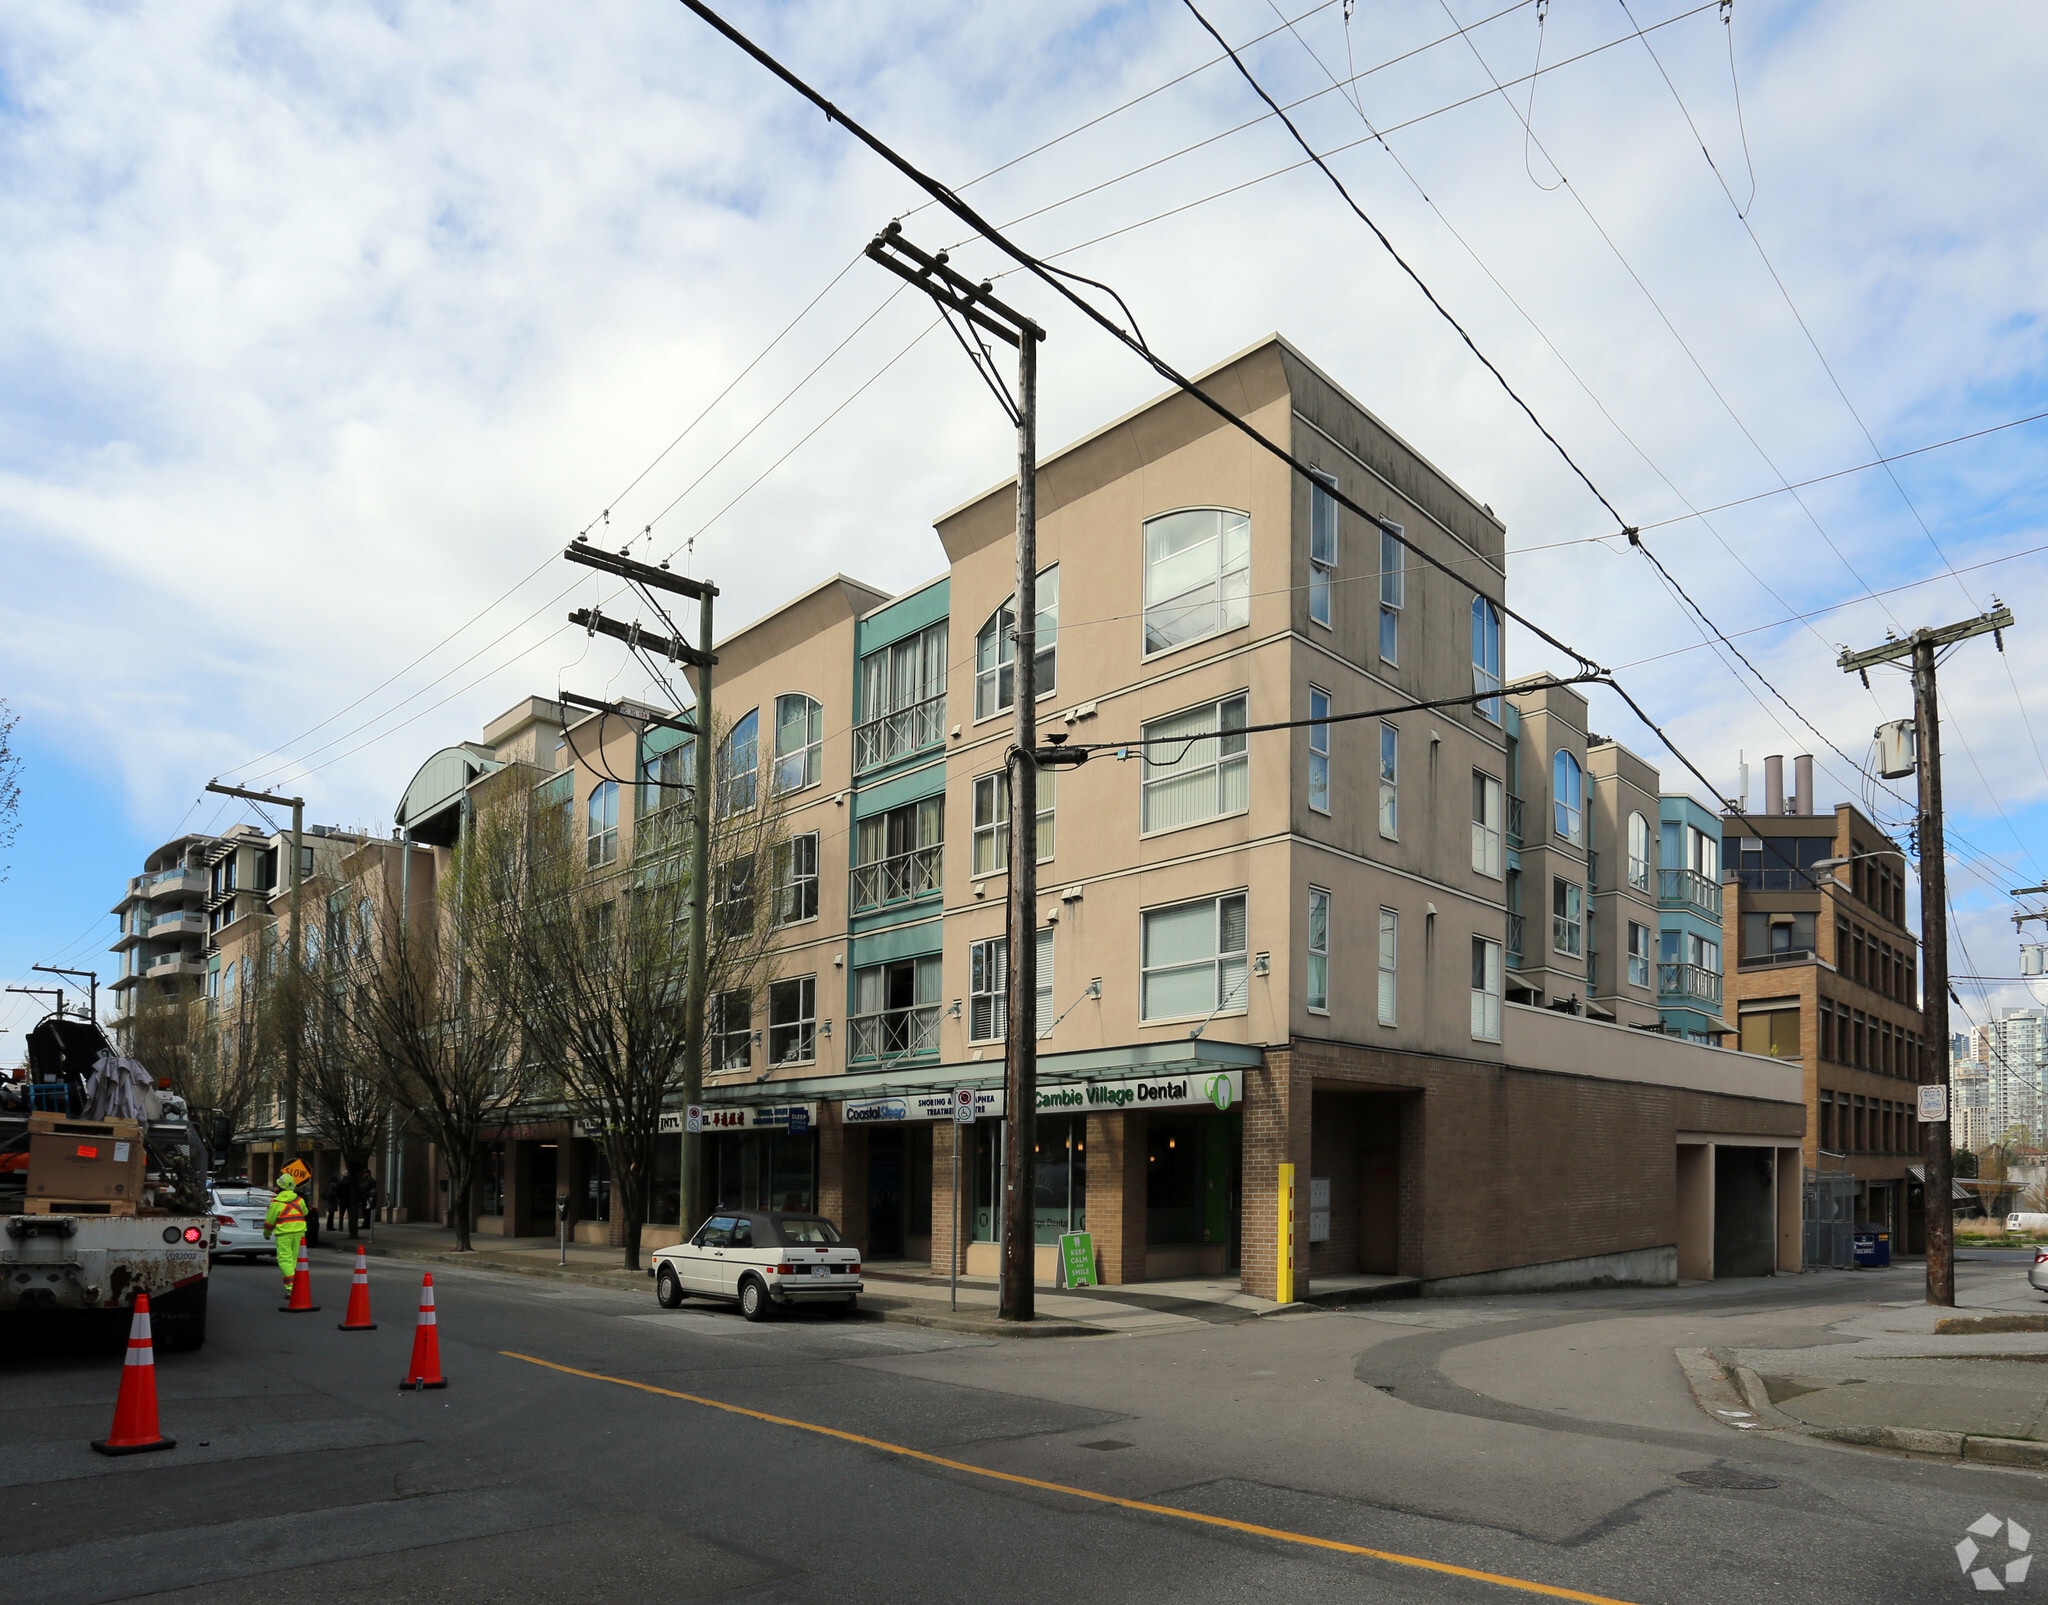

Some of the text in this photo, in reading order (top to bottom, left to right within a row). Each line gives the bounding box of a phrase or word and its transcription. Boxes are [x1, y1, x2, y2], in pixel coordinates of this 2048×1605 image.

[1035, 1080, 1188, 1108] Cambie Village Dental
[918, 1098, 945, 1108] SNORING
[1072, 1268, 1090, 1276] SMILE
